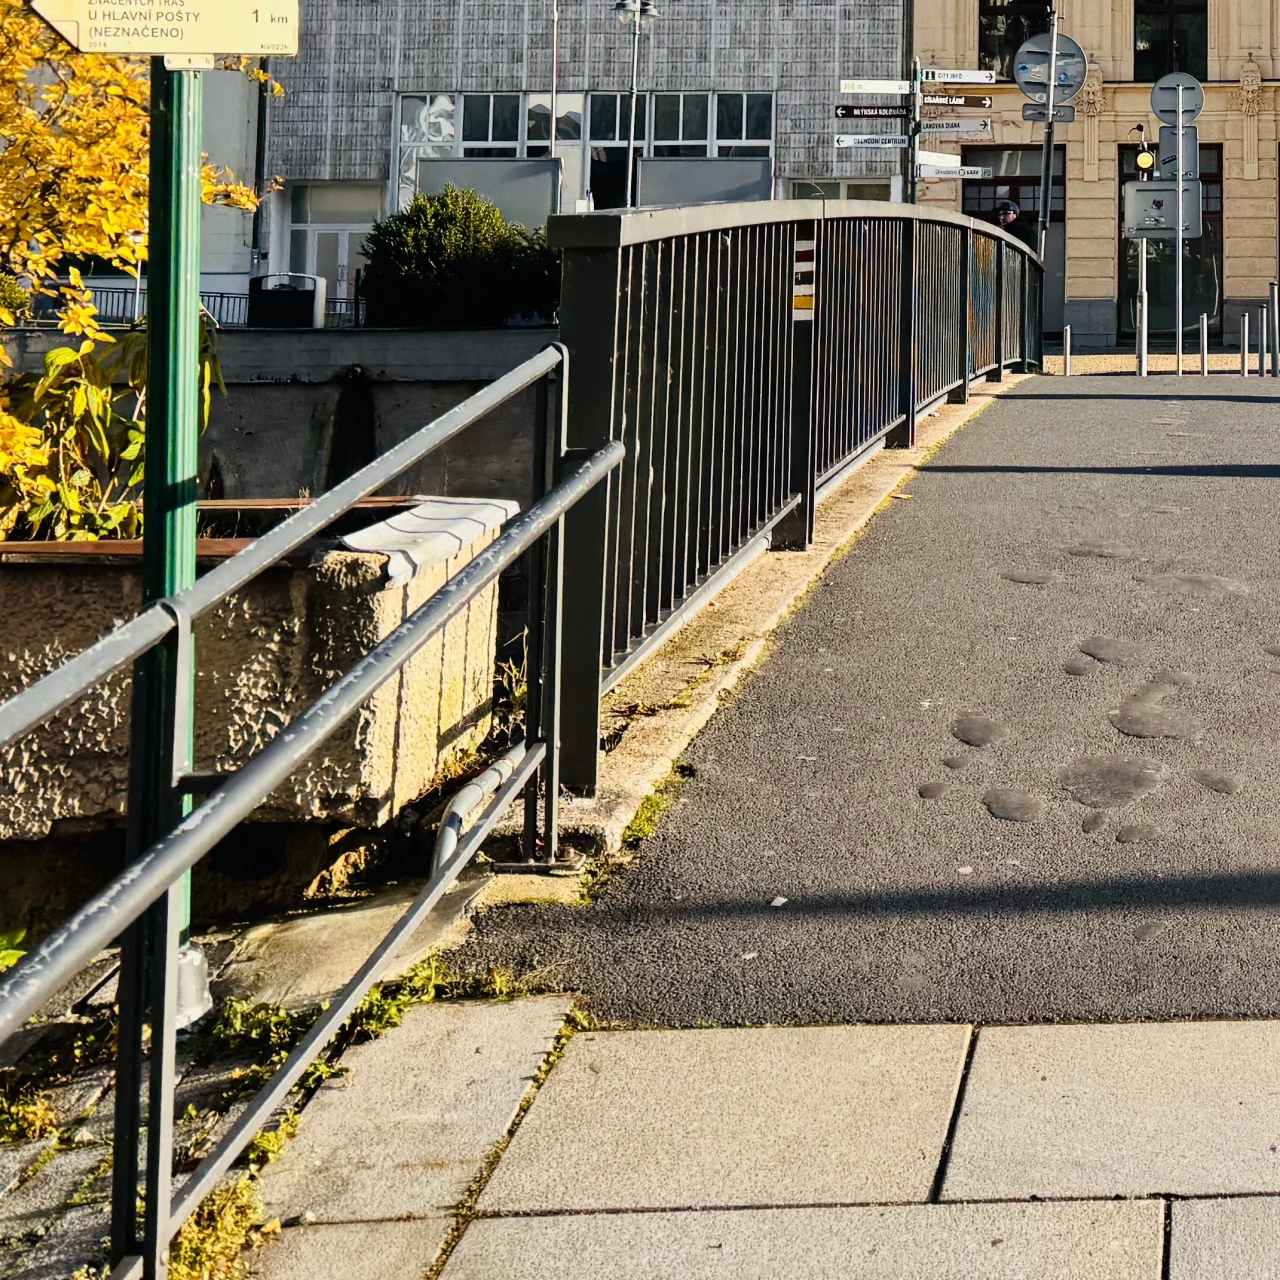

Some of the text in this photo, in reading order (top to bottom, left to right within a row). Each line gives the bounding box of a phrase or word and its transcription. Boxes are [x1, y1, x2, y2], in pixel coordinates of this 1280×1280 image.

[88, 9, 200, 23] U HLAVNÍ POŠTY
[252, 9, 288, 24] 1 km
[89, 25, 184, 40] (NEZNAČENO)
[881, 137, 906, 145] CENTRUM
